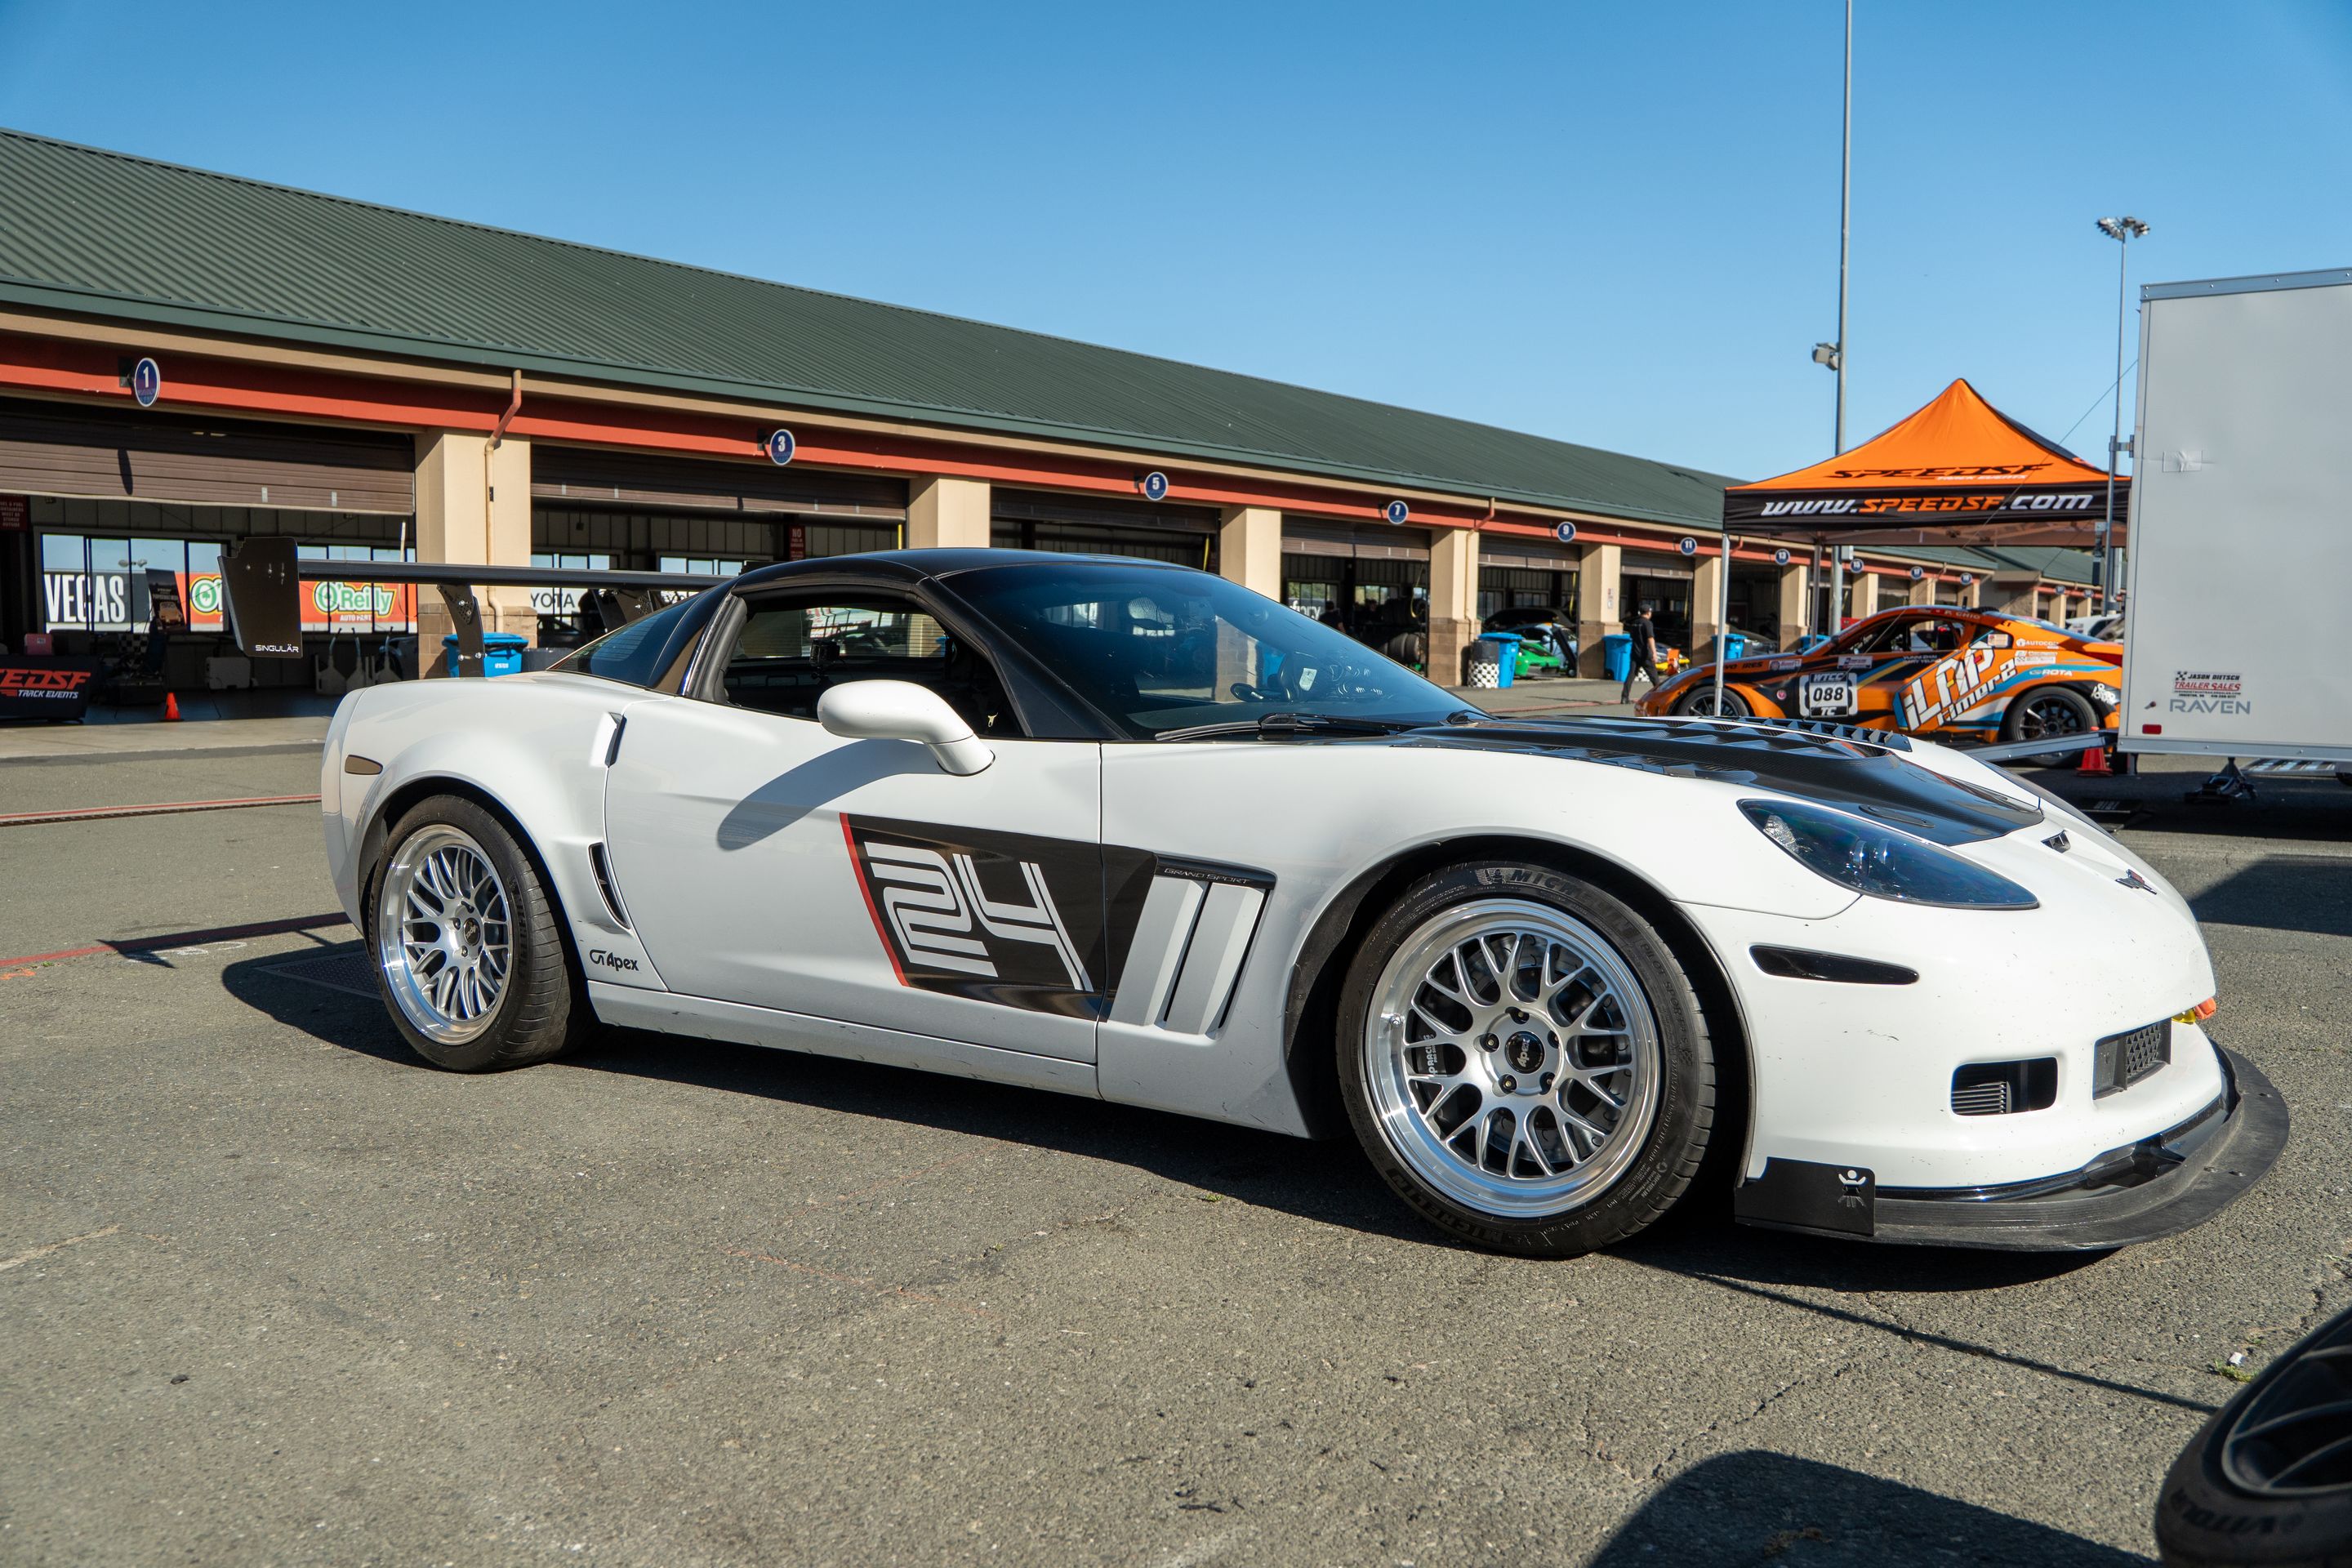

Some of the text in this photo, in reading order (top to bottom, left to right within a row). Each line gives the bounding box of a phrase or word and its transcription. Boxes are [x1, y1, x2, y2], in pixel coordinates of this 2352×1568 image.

[143, 366, 149, 388] 1
[777, 435, 786, 452] 3
[1823, 463, 2055, 479] SPEEDSF
[1152, 477, 1160, 490] 5
[792, 528, 802, 537] NO
[1684, 540, 1693, 550] 11
[44, 574, 125, 622] VEGAS
[0, 669, 91, 690] EDSF
[1813, 672, 1844, 682] WTCC
[18, 689, 78, 699] TRACK EVENTS
[2175, 681, 2241, 691] TRAILER SALES
[1813, 687, 1844, 702] 088
[1821, 706, 1838, 715] TC
[2169, 698, 2251, 715] RAVEN
[1164, 867, 1250, 884] GRAND SPORT
[864, 841, 1094, 992] 24
[607, 952, 639, 972] Apex
[1641, 942, 1667, 976] PILOT
[1663, 980, 1686, 1022] SPORT
